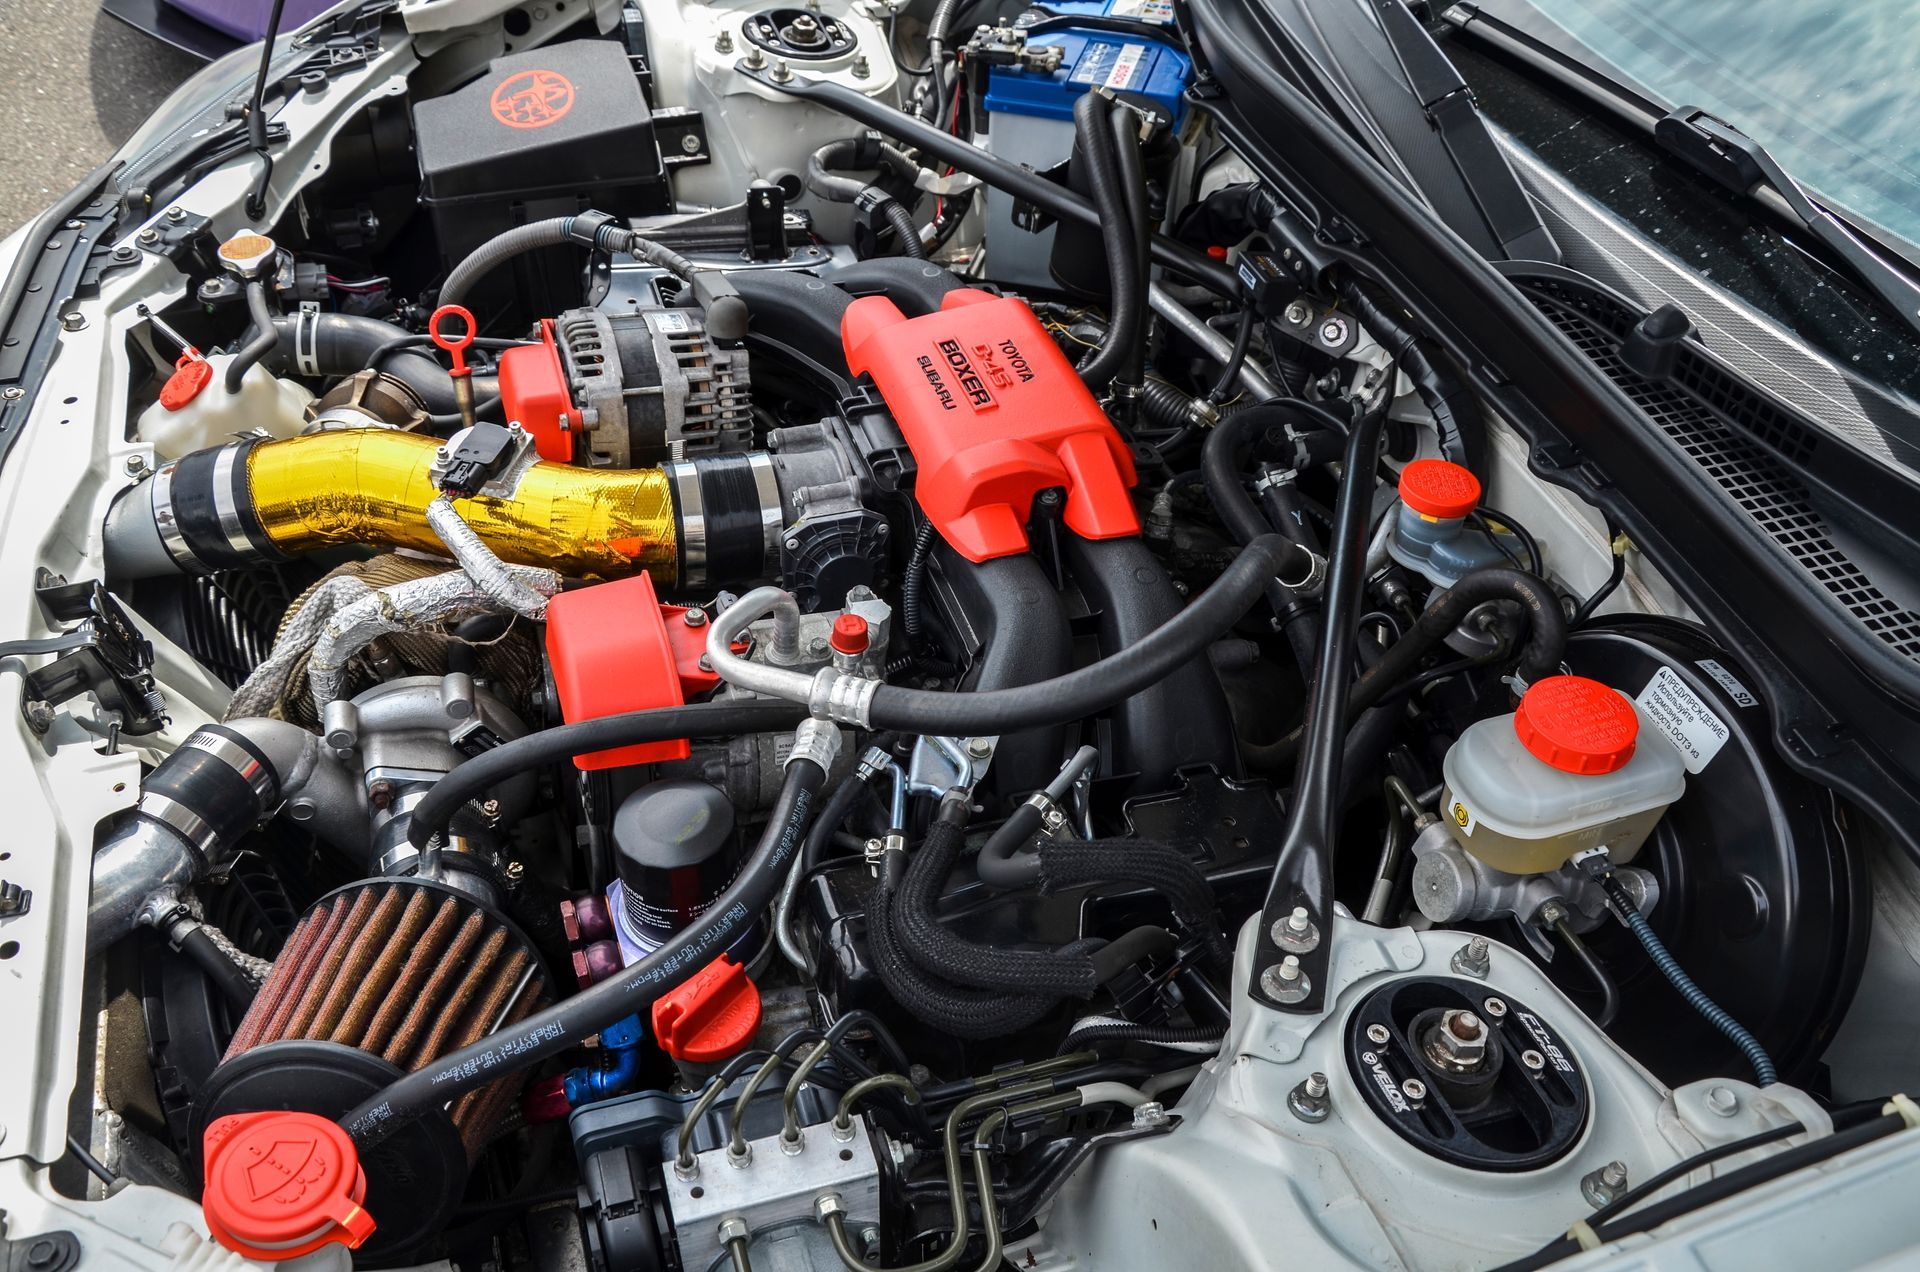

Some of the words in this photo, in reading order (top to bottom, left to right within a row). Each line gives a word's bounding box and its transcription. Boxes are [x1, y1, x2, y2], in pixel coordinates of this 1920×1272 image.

[938, 339, 991, 406] BOXER
[998, 339, 1035, 382] TOYOTA
[916, 355, 957, 411] SUBARU
[1650, 690, 1682, 725] тормозную
[1657, 681, 1695, 722] Используйте
[1664, 674, 1726, 739] ПРЕДУПРЕЖДЕНИЕ
[1733, 690, 1752, 706] SD
[1644, 699, 1672, 730] жидкость
[1670, 727, 1691, 750] DOT3
[1690, 747, 1699, 758] из
[652, 962, 679, 982] SS12
[481, 1037, 539, 1069] EDSP-11HP
[544, 1026, 565, 1040] TRG
[1518, 1013, 1574, 1072] FT-86
[453, 1065, 477, 1081] SS12
[1371, 1062, 1410, 1111] VELOX
[207, 1119, 240, 1143] PULL
